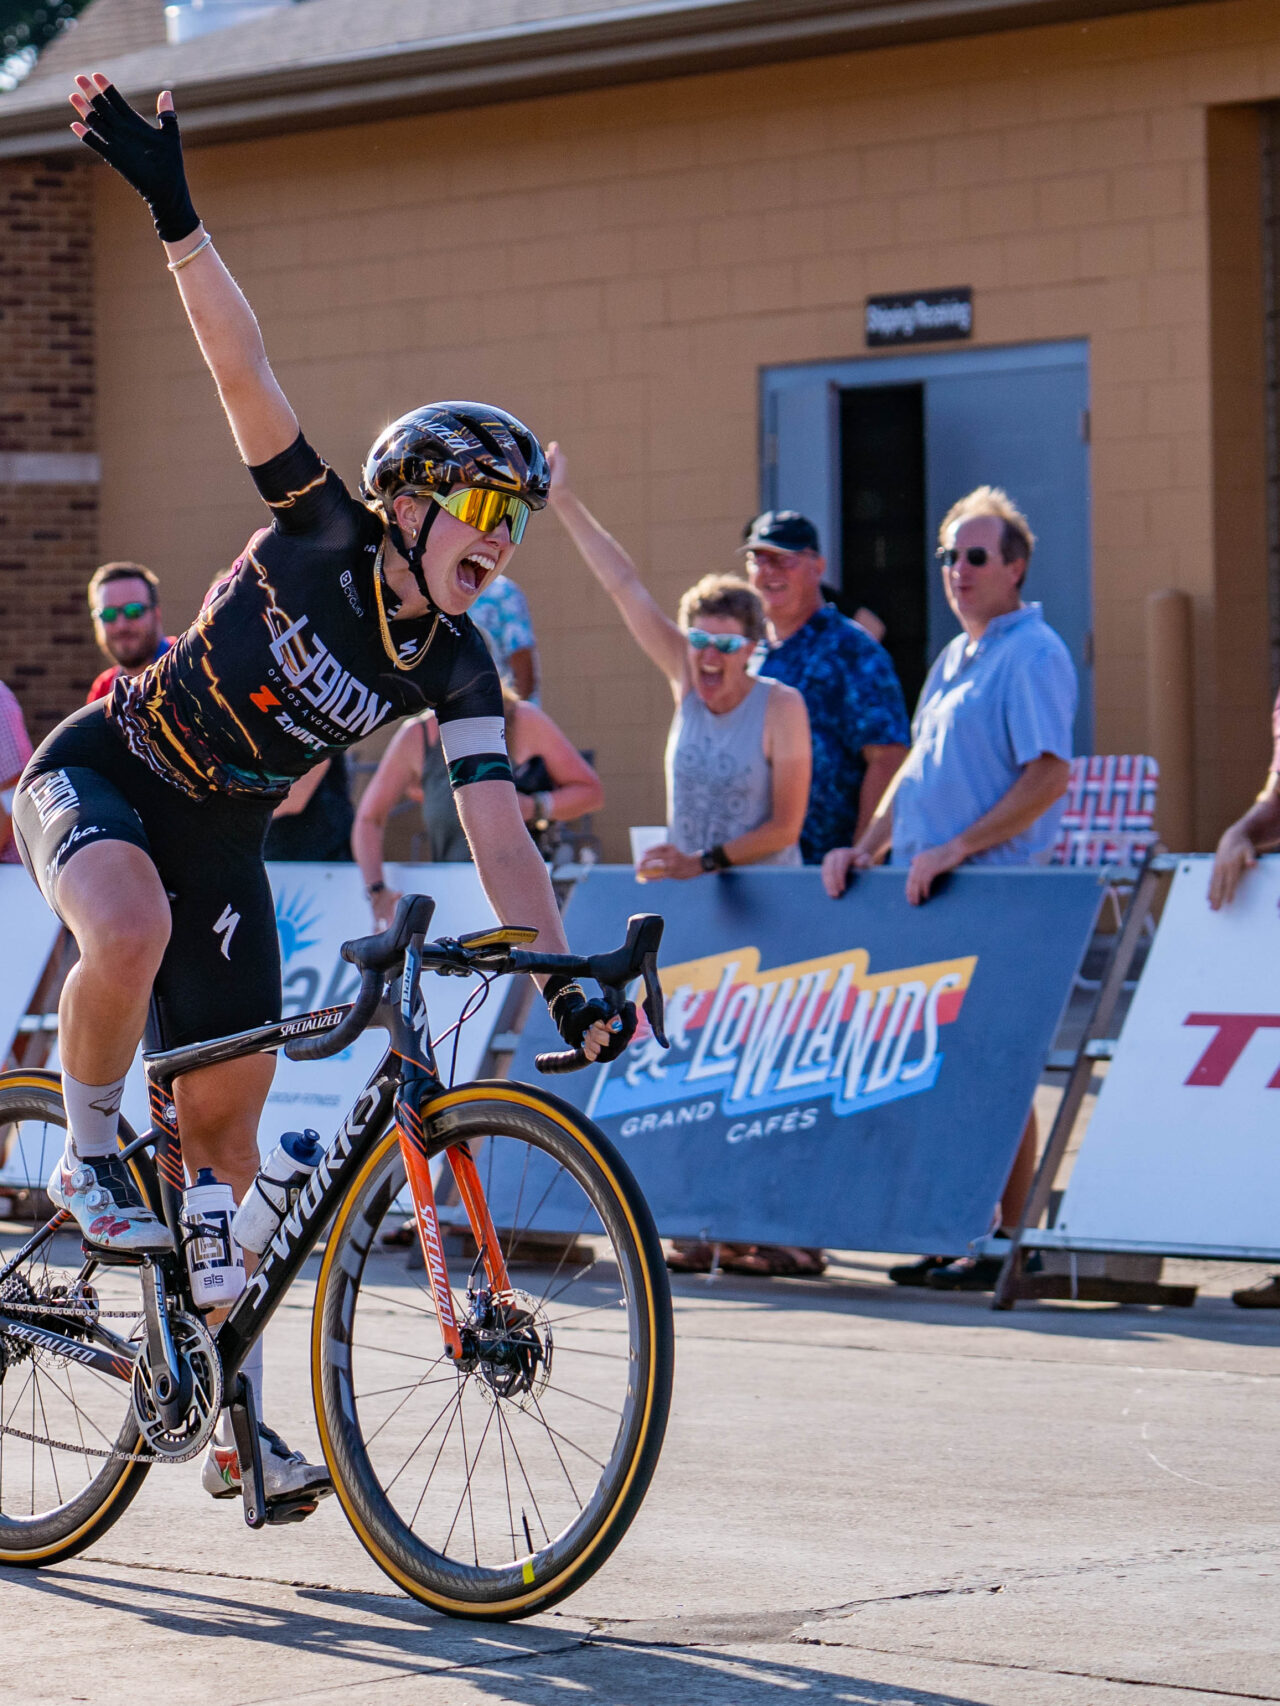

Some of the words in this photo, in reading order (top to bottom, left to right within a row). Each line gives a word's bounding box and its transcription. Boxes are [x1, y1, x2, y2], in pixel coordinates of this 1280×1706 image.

[267, 668, 282, 683] OF
[280, 686, 301, 707] LOS
[301, 709, 348, 742] ANGELES
[274, 711, 329, 751] ZWIFT
[280, 1011, 344, 1037] SPECIALIZED
[1181, 1011, 1280, 1089] T
[620, 1101, 715, 1138] GRAND
[726, 1107, 819, 1144] CAFÉS
[228, 1085, 382, 1323] S-WORKS
[419, 1203, 454, 1327] SPECIALIZED
[3, 1323, 97, 1363] SPECIALIZED
